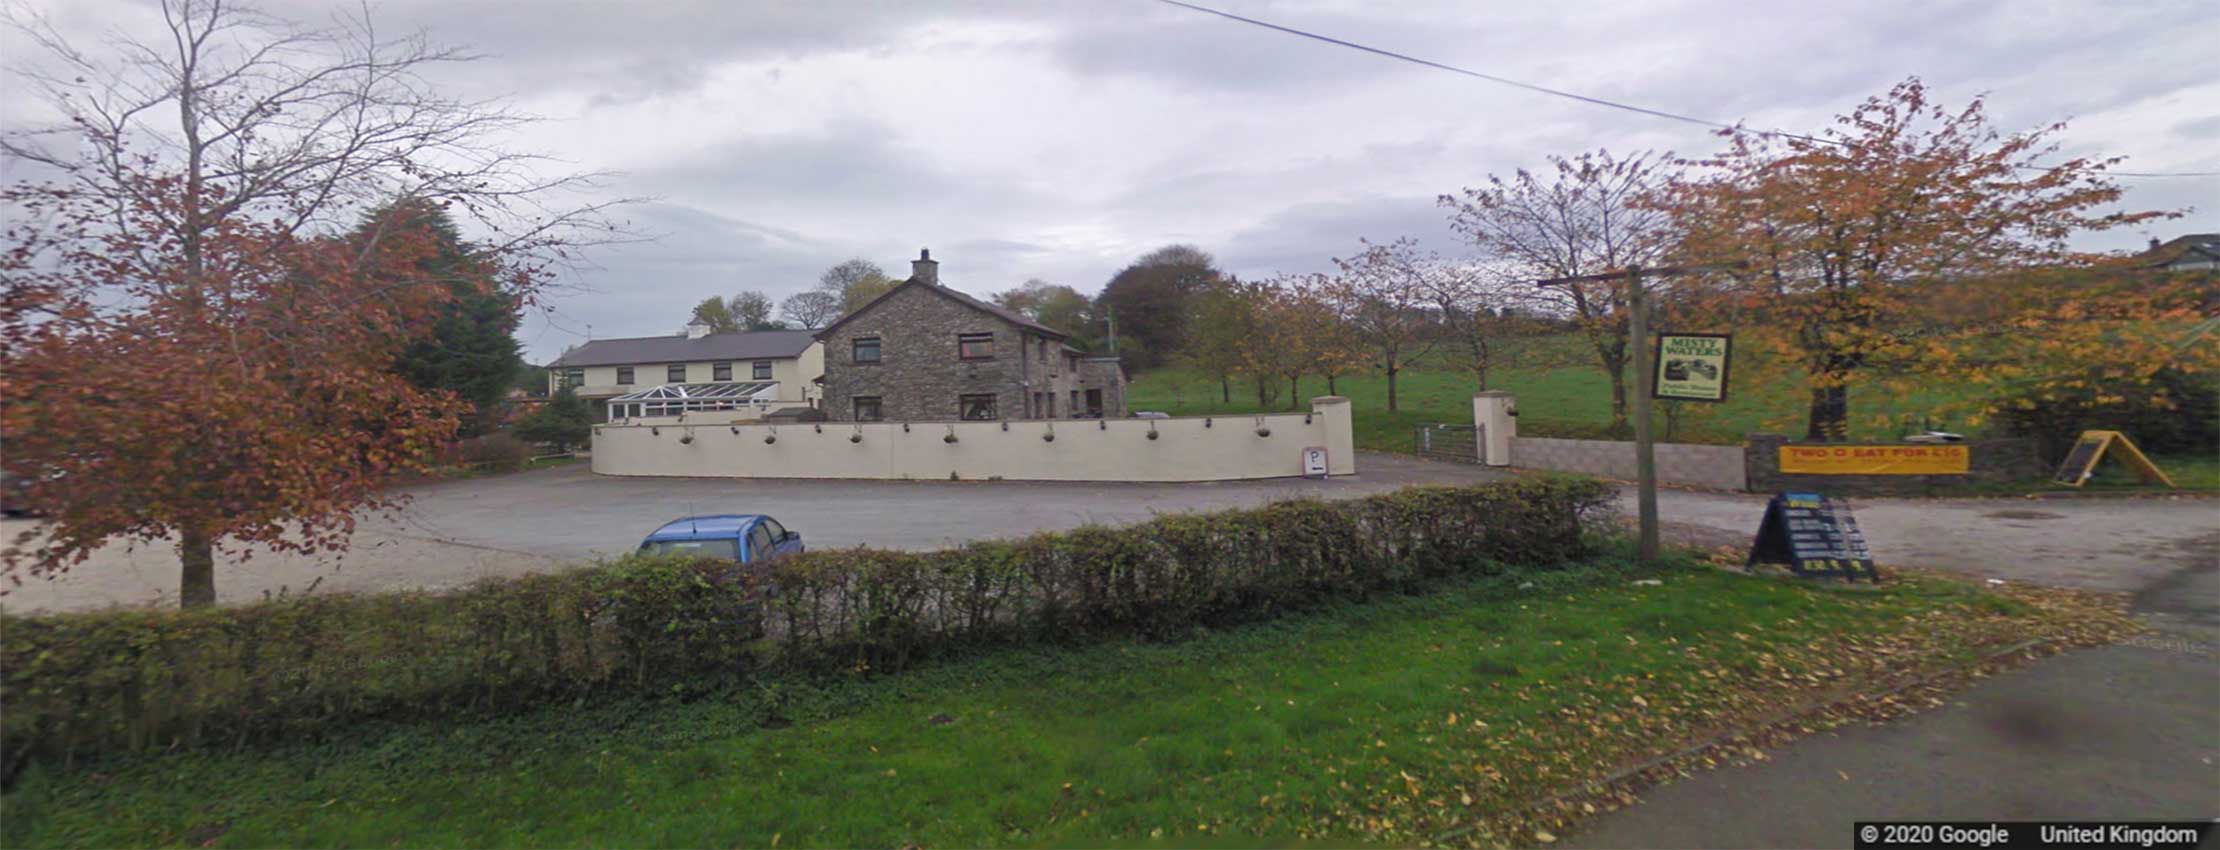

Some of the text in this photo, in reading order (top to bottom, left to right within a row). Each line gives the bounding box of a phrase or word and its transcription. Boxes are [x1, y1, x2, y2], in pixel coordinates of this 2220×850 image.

[1672, 337, 1716, 348] MISTY
[1665, 346, 1722, 356] WATERS
[1311, 451, 1319, 462] P
[1792, 447, 1827, 458] TWO
[1853, 447, 1887, 458] EAT
[1892, 447, 1927, 458] FOR
